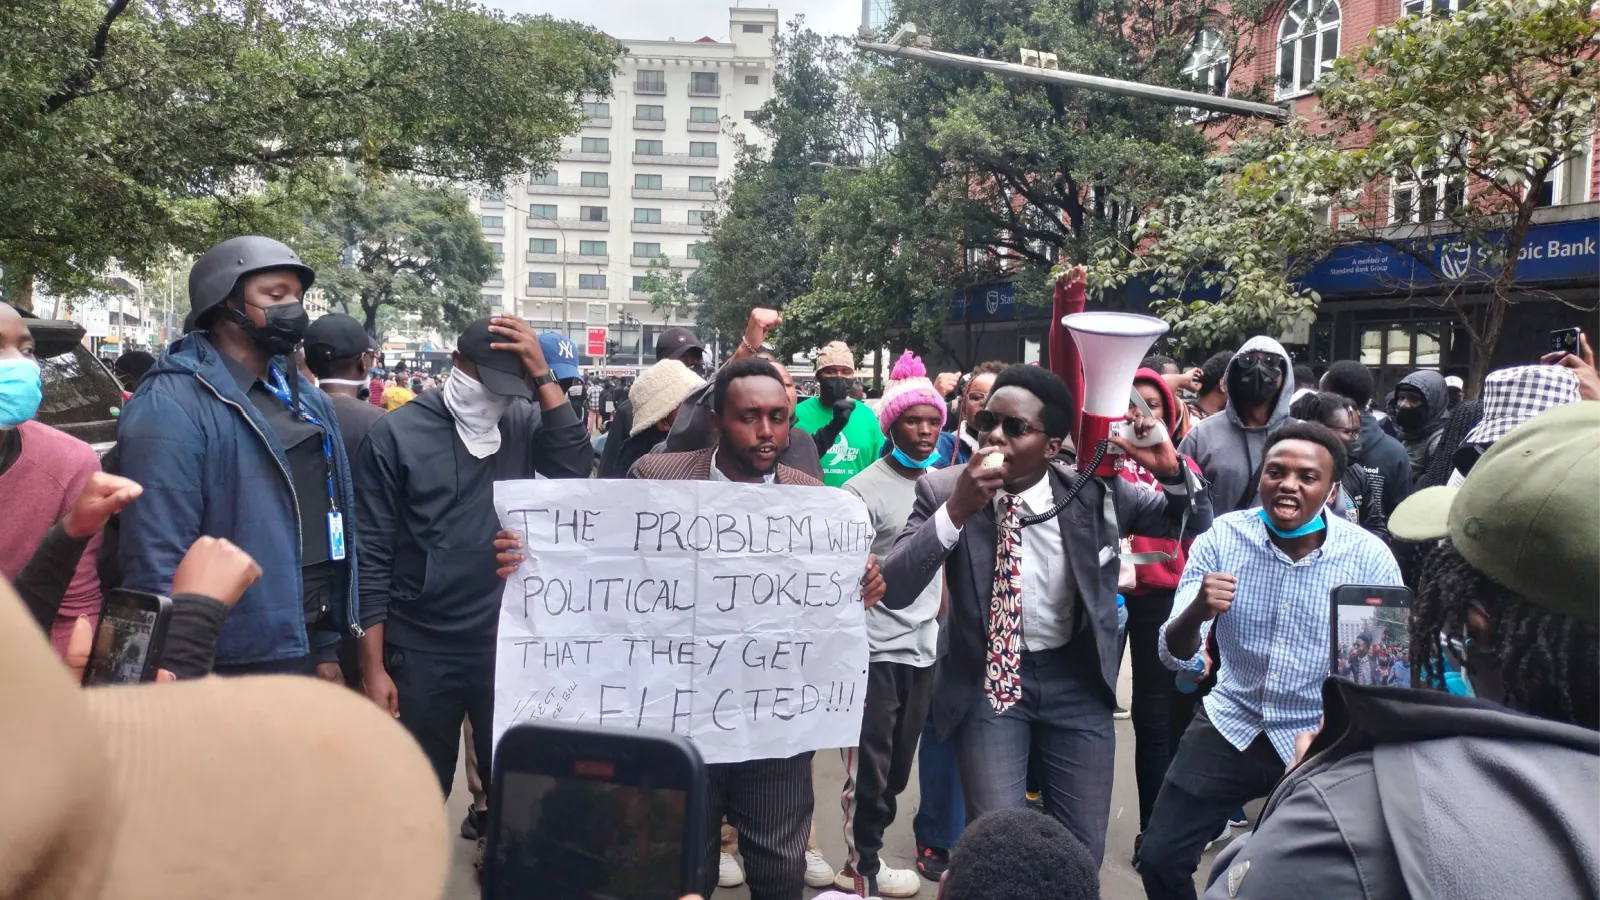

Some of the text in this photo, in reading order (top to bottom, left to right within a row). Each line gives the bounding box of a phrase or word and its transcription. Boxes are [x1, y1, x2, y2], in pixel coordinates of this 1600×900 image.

[1357, 256, 1380, 265] member
[1381, 255, 1389, 263] of
[1476, 236, 1596, 263] Sbic Bank
[1330, 264, 1388, 275] Standard Bank Group
[1000, 294, 1016, 305] Stan
[558, 340, 574, 359] NY
[507, 508, 874, 553] THE PROBLEM WITH
[523, 575, 695, 619] POLITICAL
[713, 571, 842, 613] JOKES
[513, 637, 814, 676] THAT THEY GET
